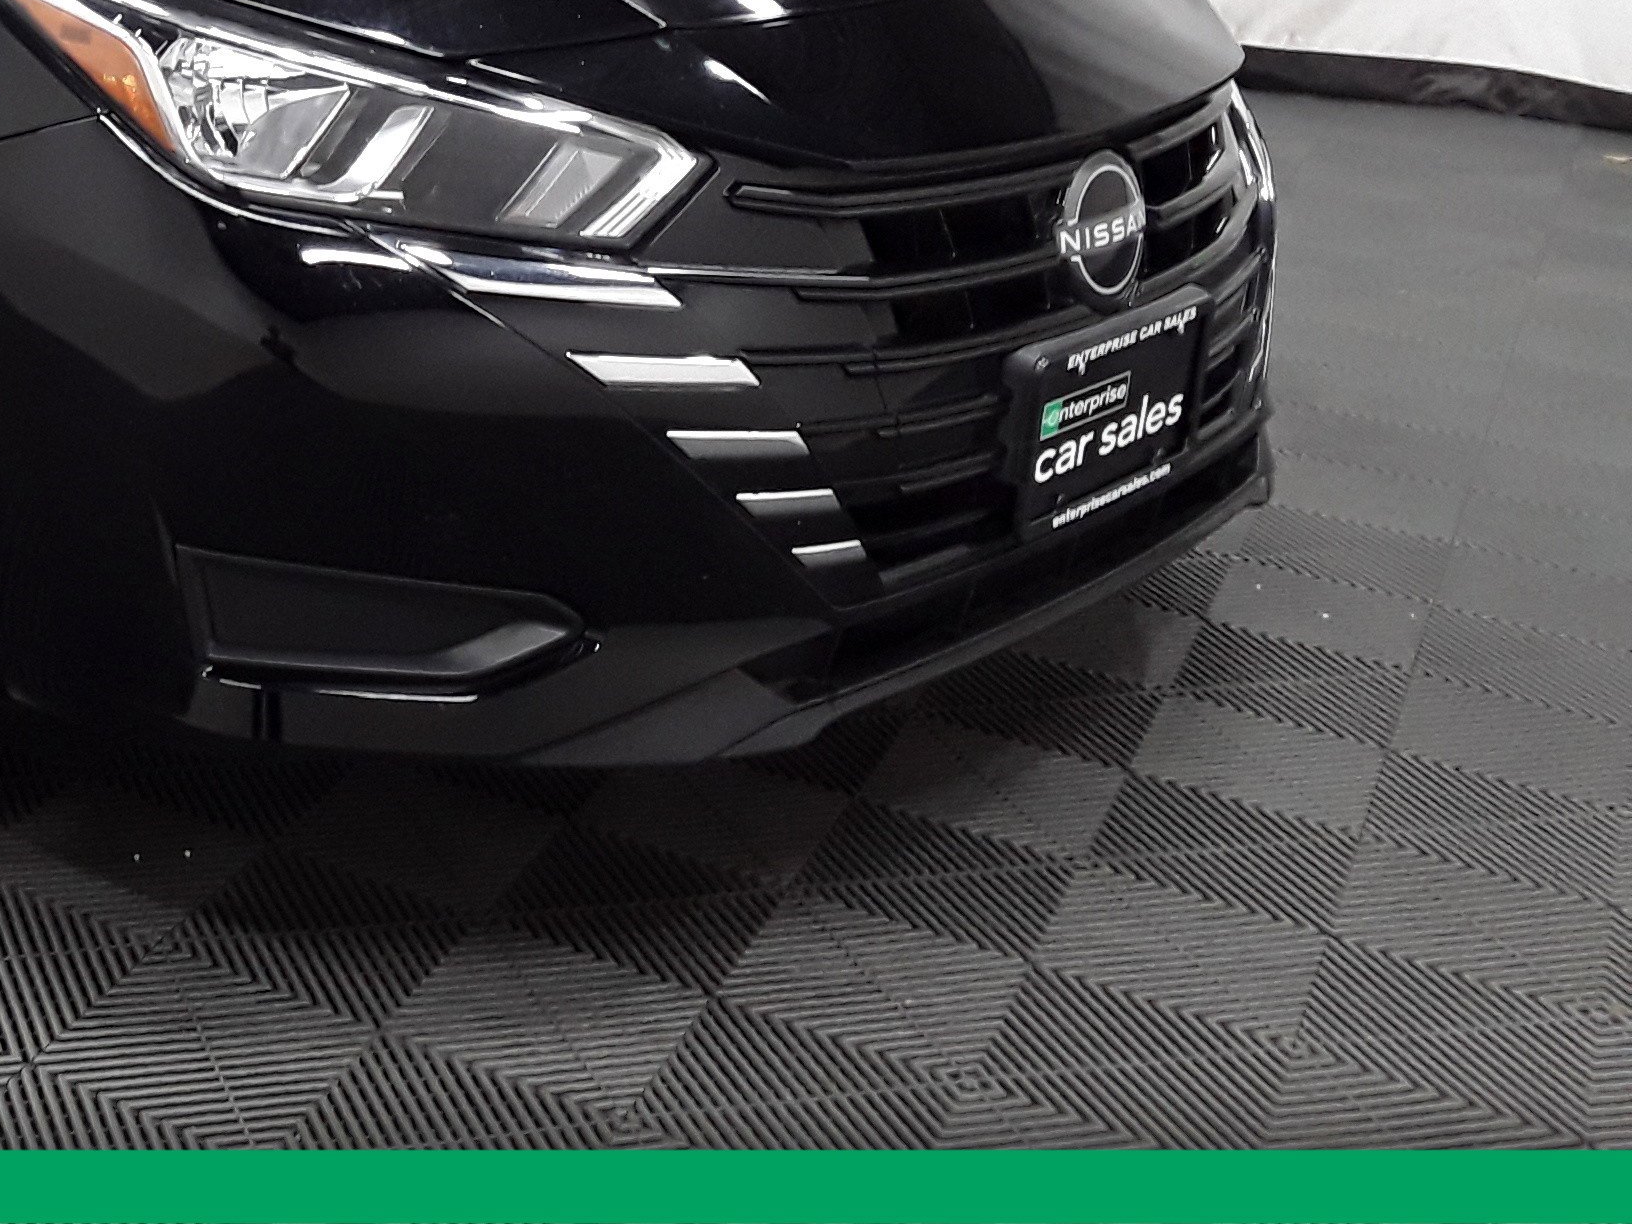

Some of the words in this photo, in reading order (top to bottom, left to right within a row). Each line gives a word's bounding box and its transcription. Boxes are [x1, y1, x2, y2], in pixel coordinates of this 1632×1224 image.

[1060, 208, 1146, 254] NISSAN
[1067, 329, 1138, 376] ENTERPRISE
[1139, 320, 1163, 342] CAR
[1164, 306, 1197, 334] SALES
[1045, 383, 1127, 428] enterprise
[1034, 430, 1095, 484] car
[1098, 393, 1184, 456] sales
